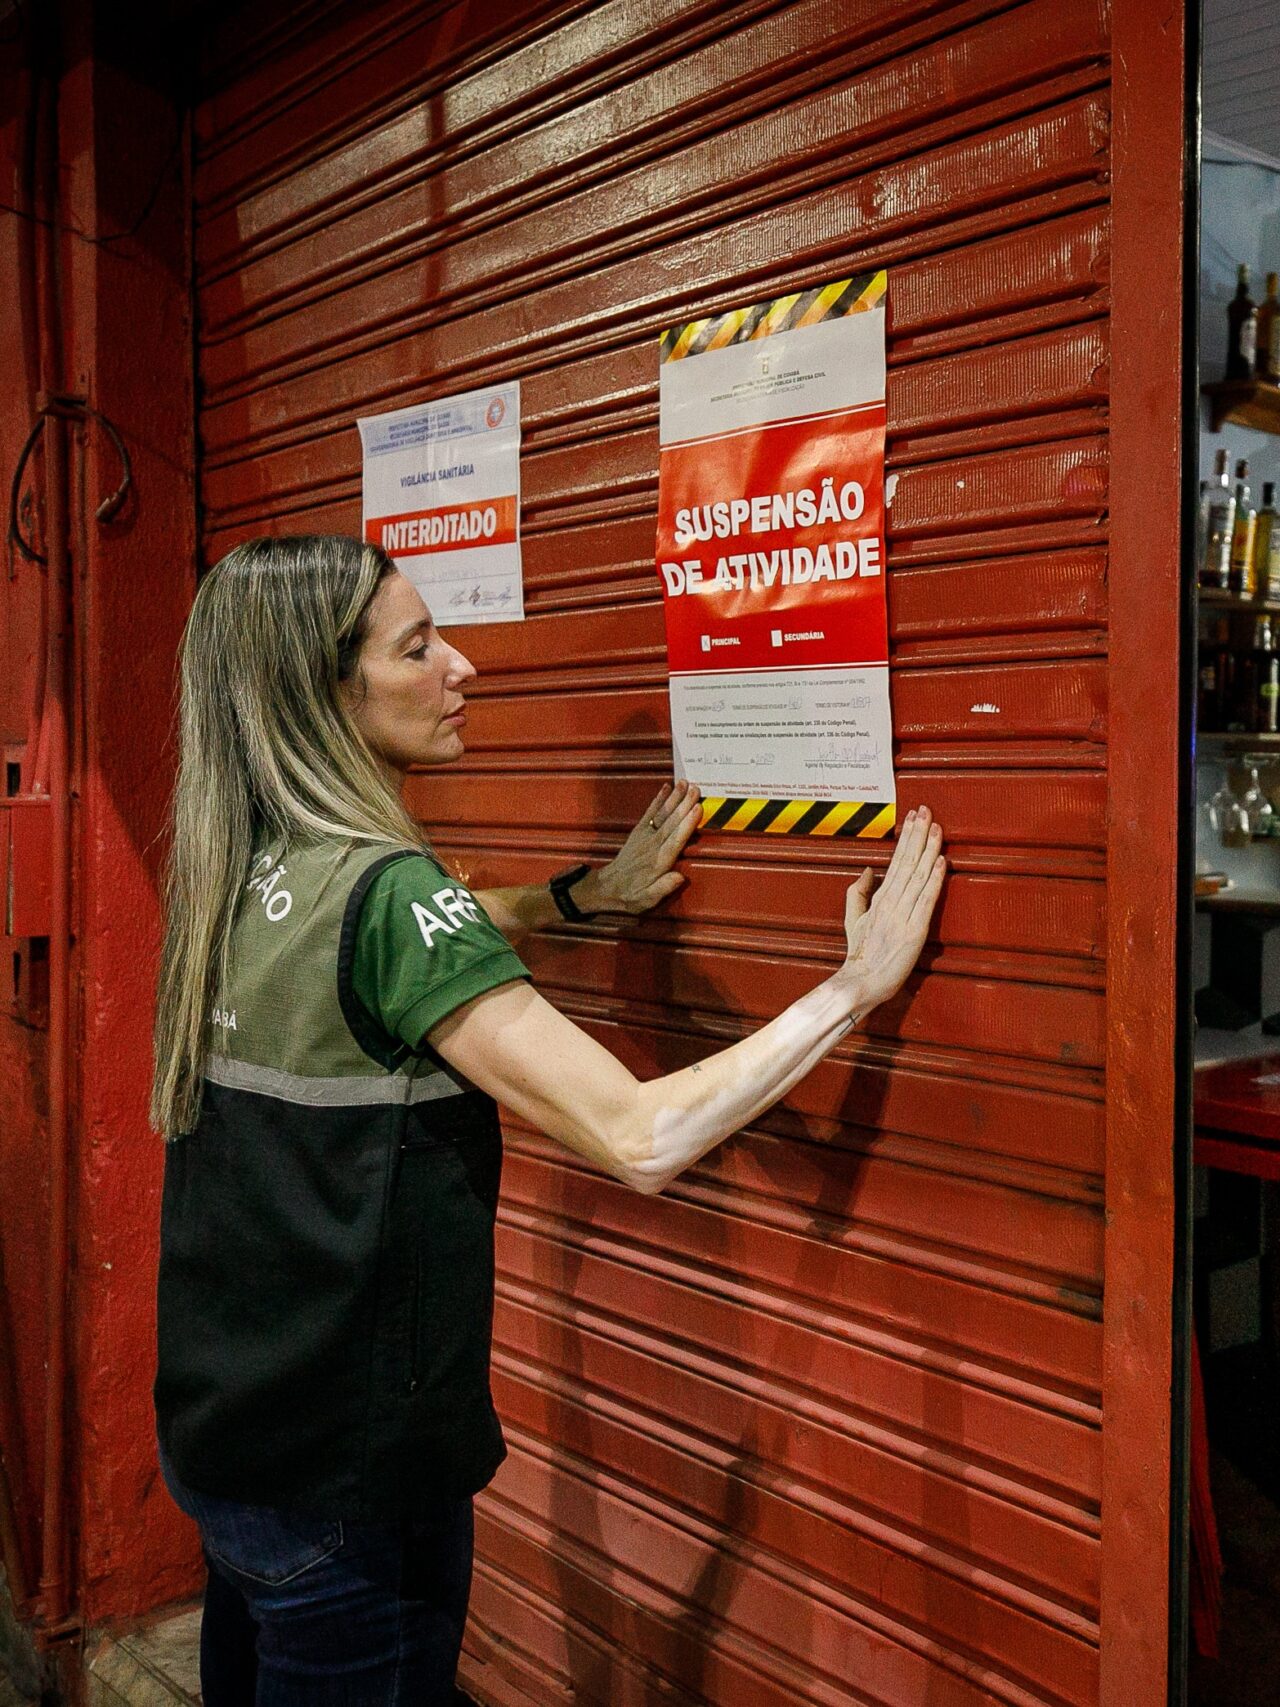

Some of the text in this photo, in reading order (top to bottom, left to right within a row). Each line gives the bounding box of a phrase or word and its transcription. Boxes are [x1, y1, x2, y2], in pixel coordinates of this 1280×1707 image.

[438, 463, 475, 481] SANITÁRIA
[674, 476, 865, 544] SUSPENSÃO
[382, 506, 497, 551] INTERDITADO
[661, 537, 881, 598] DE ATIVIDADE
[711, 637, 741, 646] PRINCIPAL
[784, 631, 825, 642] SECUNDÁRIA
